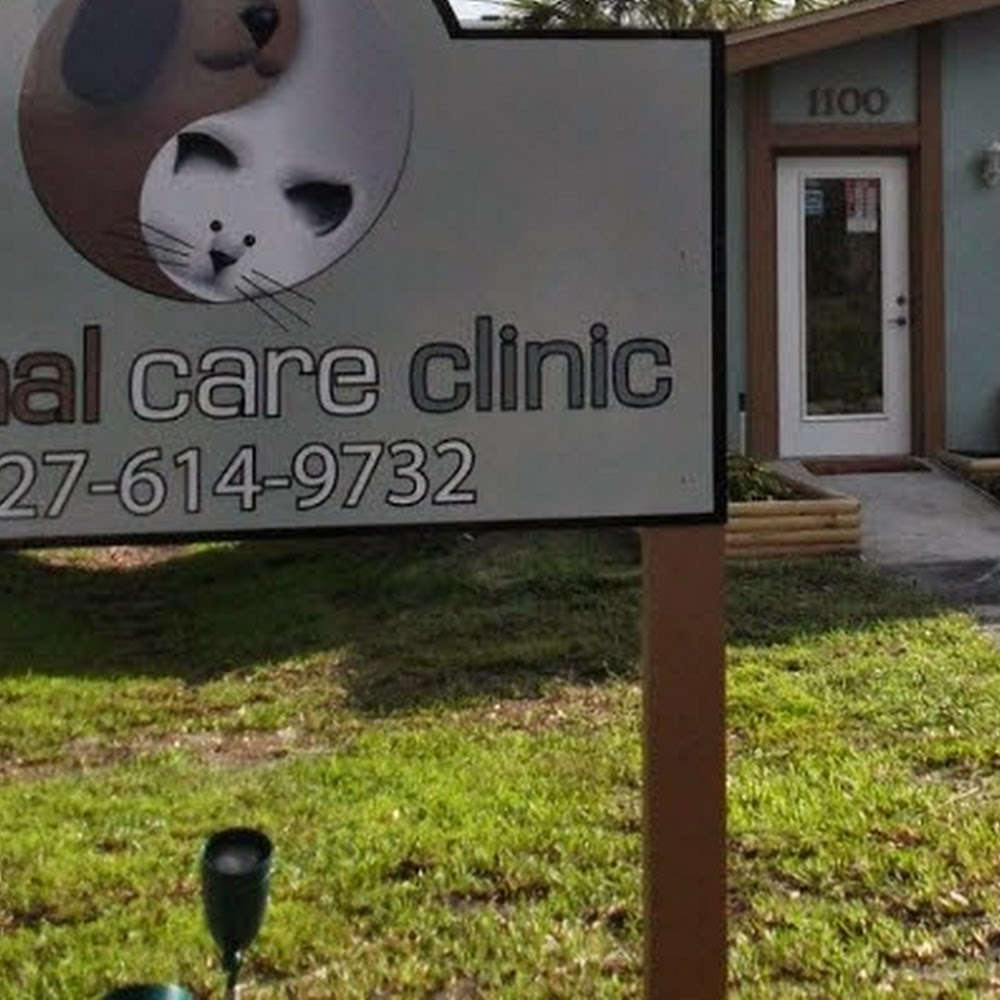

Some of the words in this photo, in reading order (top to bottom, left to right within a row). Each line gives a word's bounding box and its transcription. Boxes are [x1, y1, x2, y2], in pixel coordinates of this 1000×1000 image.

[808, 85, 889, 117] 1100
[0, 325, 101, 426] al
[129, 345, 379, 421] care
[409, 316, 673, 413] clinic
[0, 438, 478, 520] 27-614-9732
